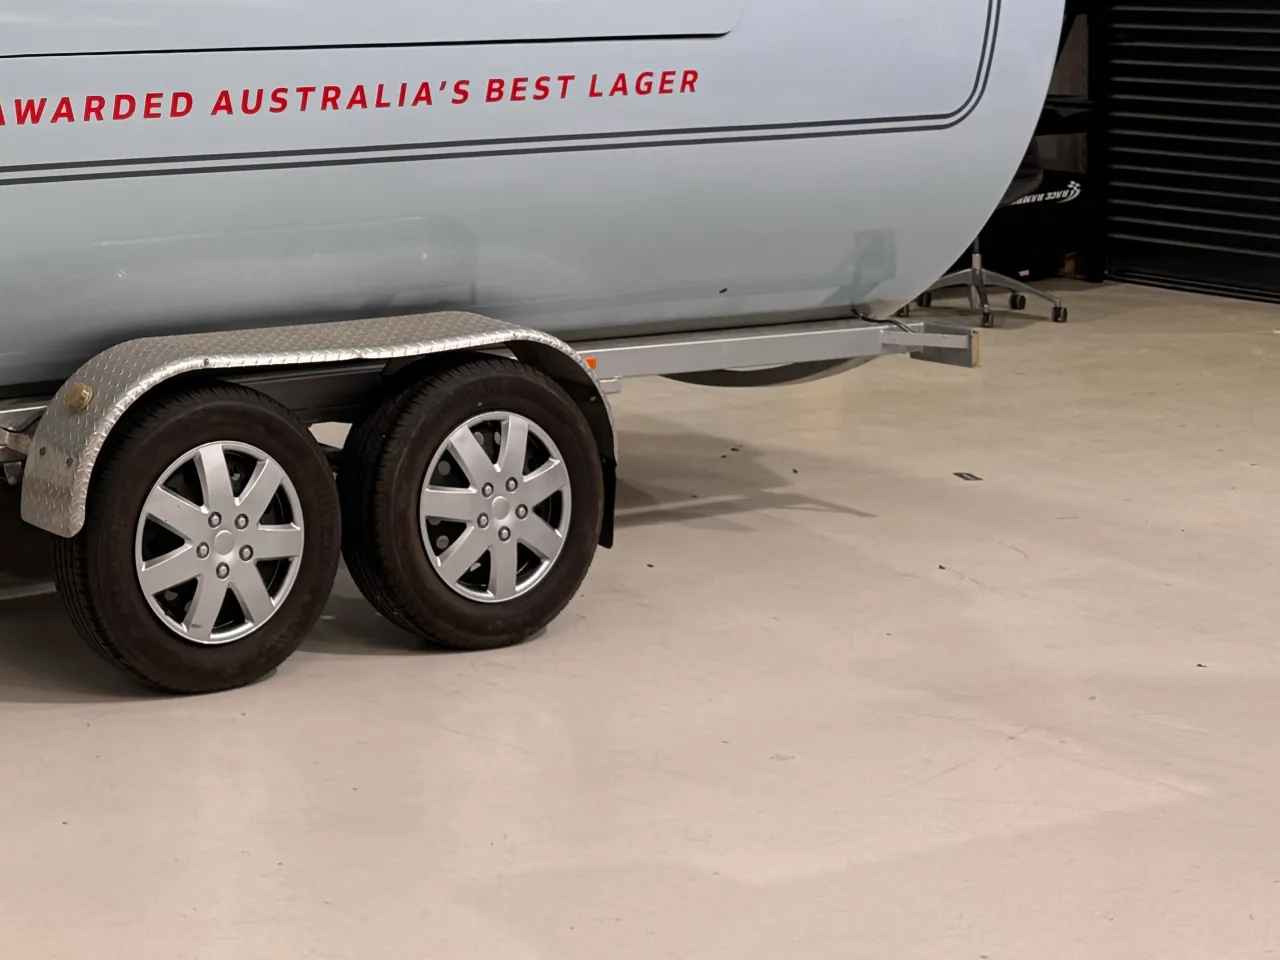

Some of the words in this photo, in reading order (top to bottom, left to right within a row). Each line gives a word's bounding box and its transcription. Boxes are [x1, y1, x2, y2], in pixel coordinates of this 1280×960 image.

[210, 79, 471, 115] AUSTRALIA’S
[484, 74, 576, 104] BEST
[587, 69, 700, 99] LAGER
[1045, 189, 1070, 200] RACE
